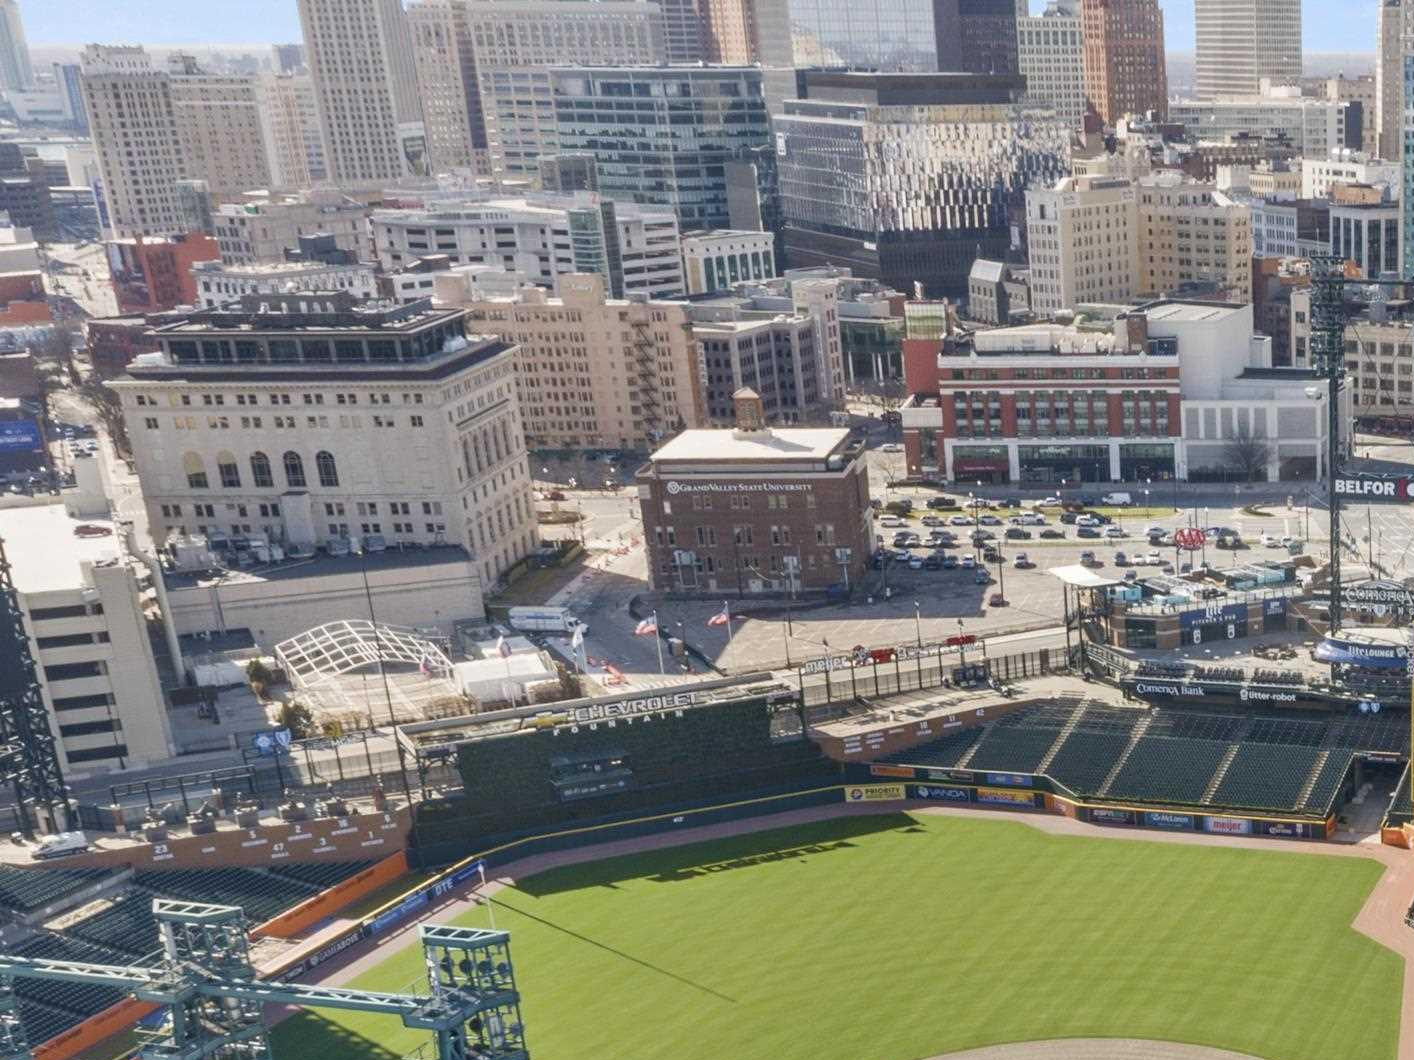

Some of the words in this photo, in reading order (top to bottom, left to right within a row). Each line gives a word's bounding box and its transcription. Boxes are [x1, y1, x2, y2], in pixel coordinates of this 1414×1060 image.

[1335, 479, 1395, 496] BELFOR
[574, 693, 697, 722] CHEVROLET
[553, 709, 684, 737] FOUNTAIN
[864, 786, 901, 796] PRIORITY
[1213, 820, 1242, 831] meijer
[154, 844, 168, 854] 23
